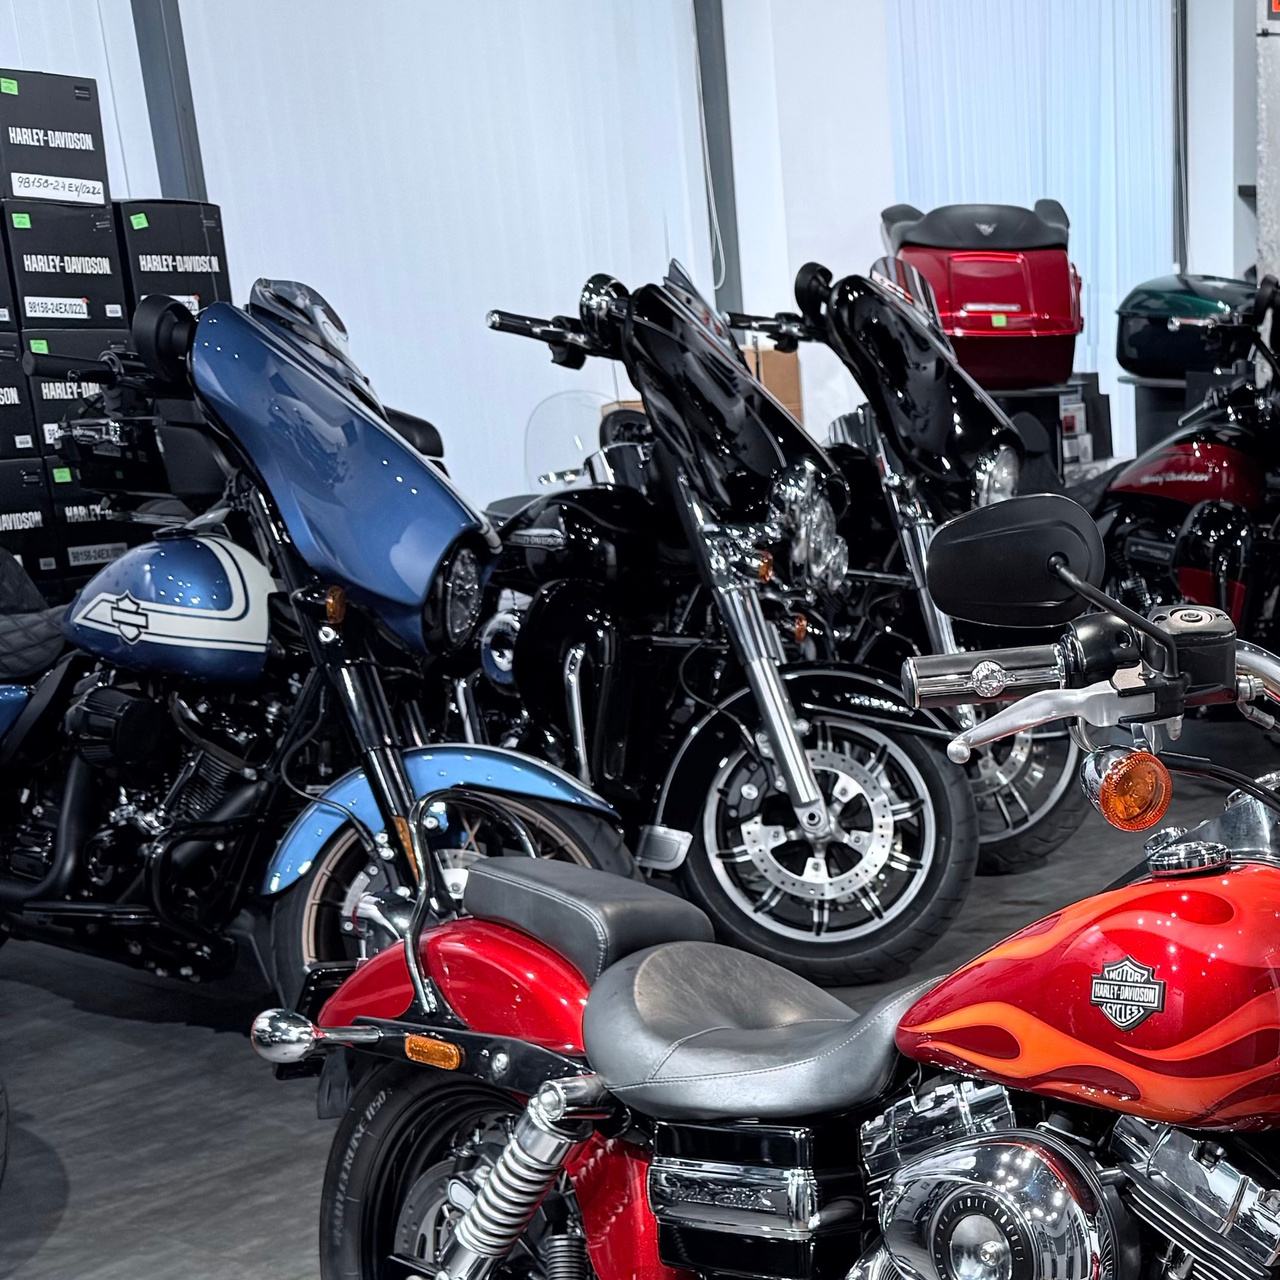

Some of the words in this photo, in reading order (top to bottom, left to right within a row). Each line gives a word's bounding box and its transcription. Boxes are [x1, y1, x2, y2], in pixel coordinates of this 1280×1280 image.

[9, 126, 94, 151] HARLEY-DAVIDSON
[23, 254, 112, 274] HARLEY-DAVIDSON
[1109, 969, 1143, 983] MOTOR
[1094, 983, 1156, 1003] HARLEY-DAVIDSON
[1106, 1004, 1139, 1022] CYCLES
